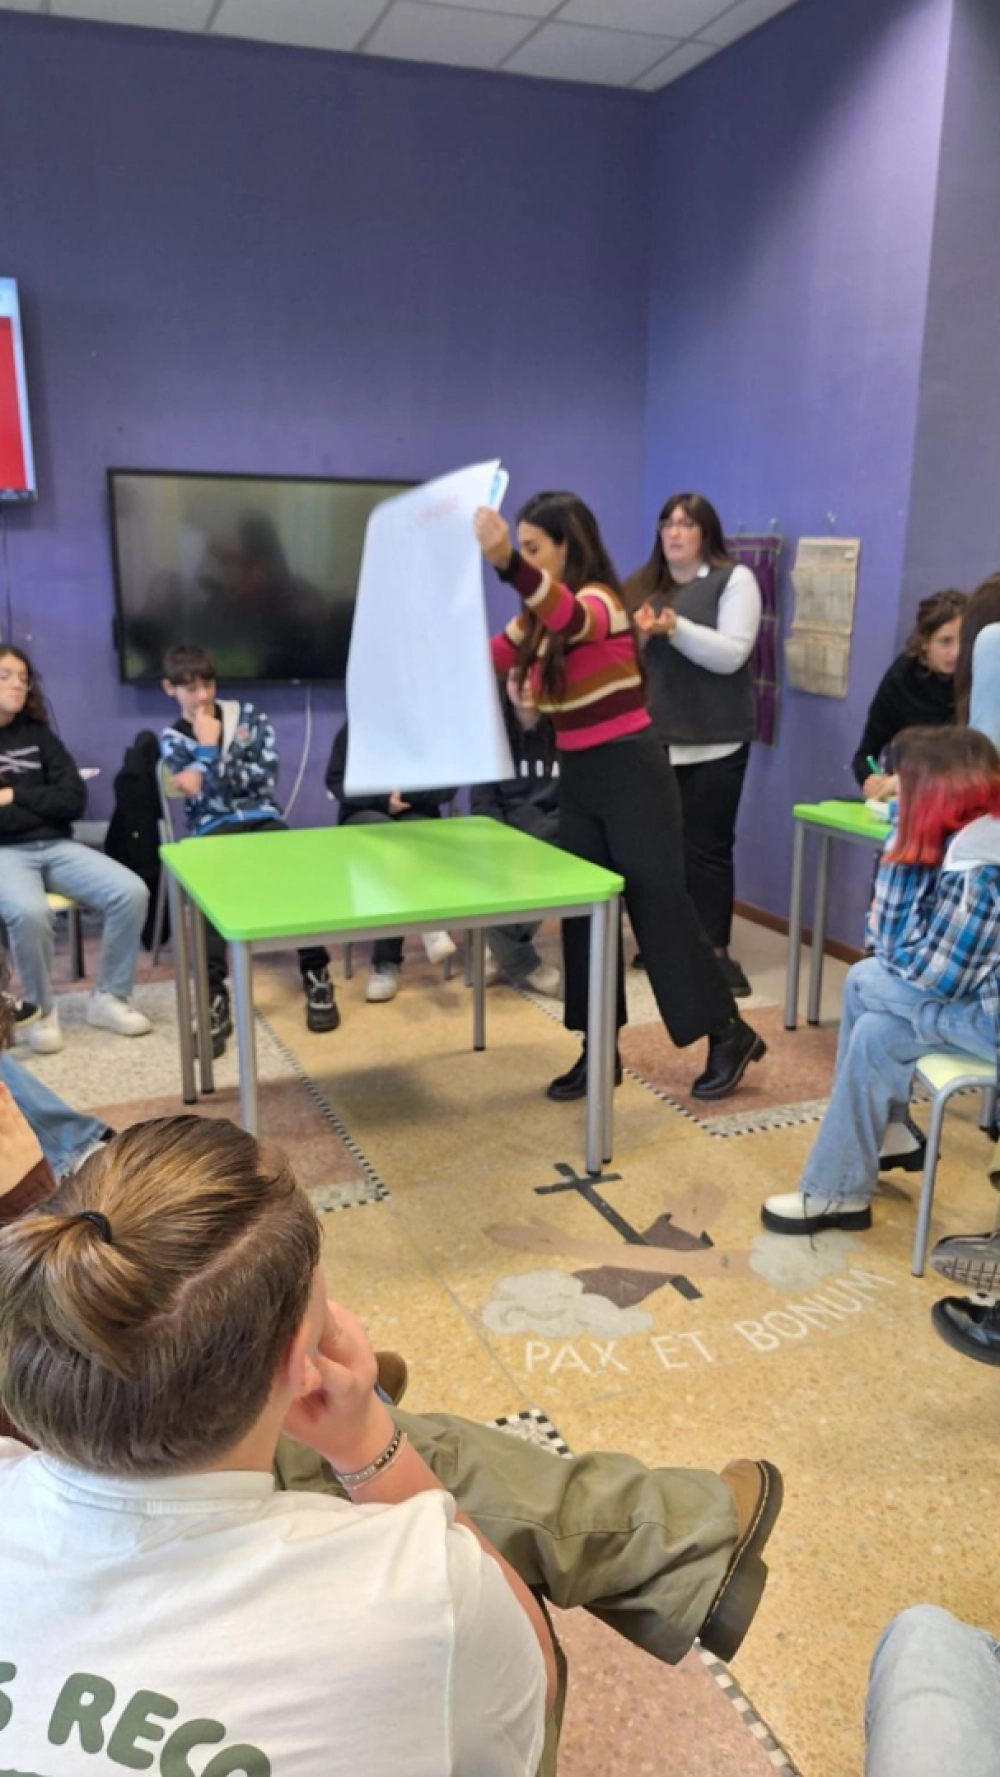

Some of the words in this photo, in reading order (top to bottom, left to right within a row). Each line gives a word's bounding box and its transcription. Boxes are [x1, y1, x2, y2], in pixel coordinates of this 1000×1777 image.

[524, 1341, 630, 1375] PAX
[650, 1331, 715, 1370] ET
[733, 1268, 897, 1353] BONUM
